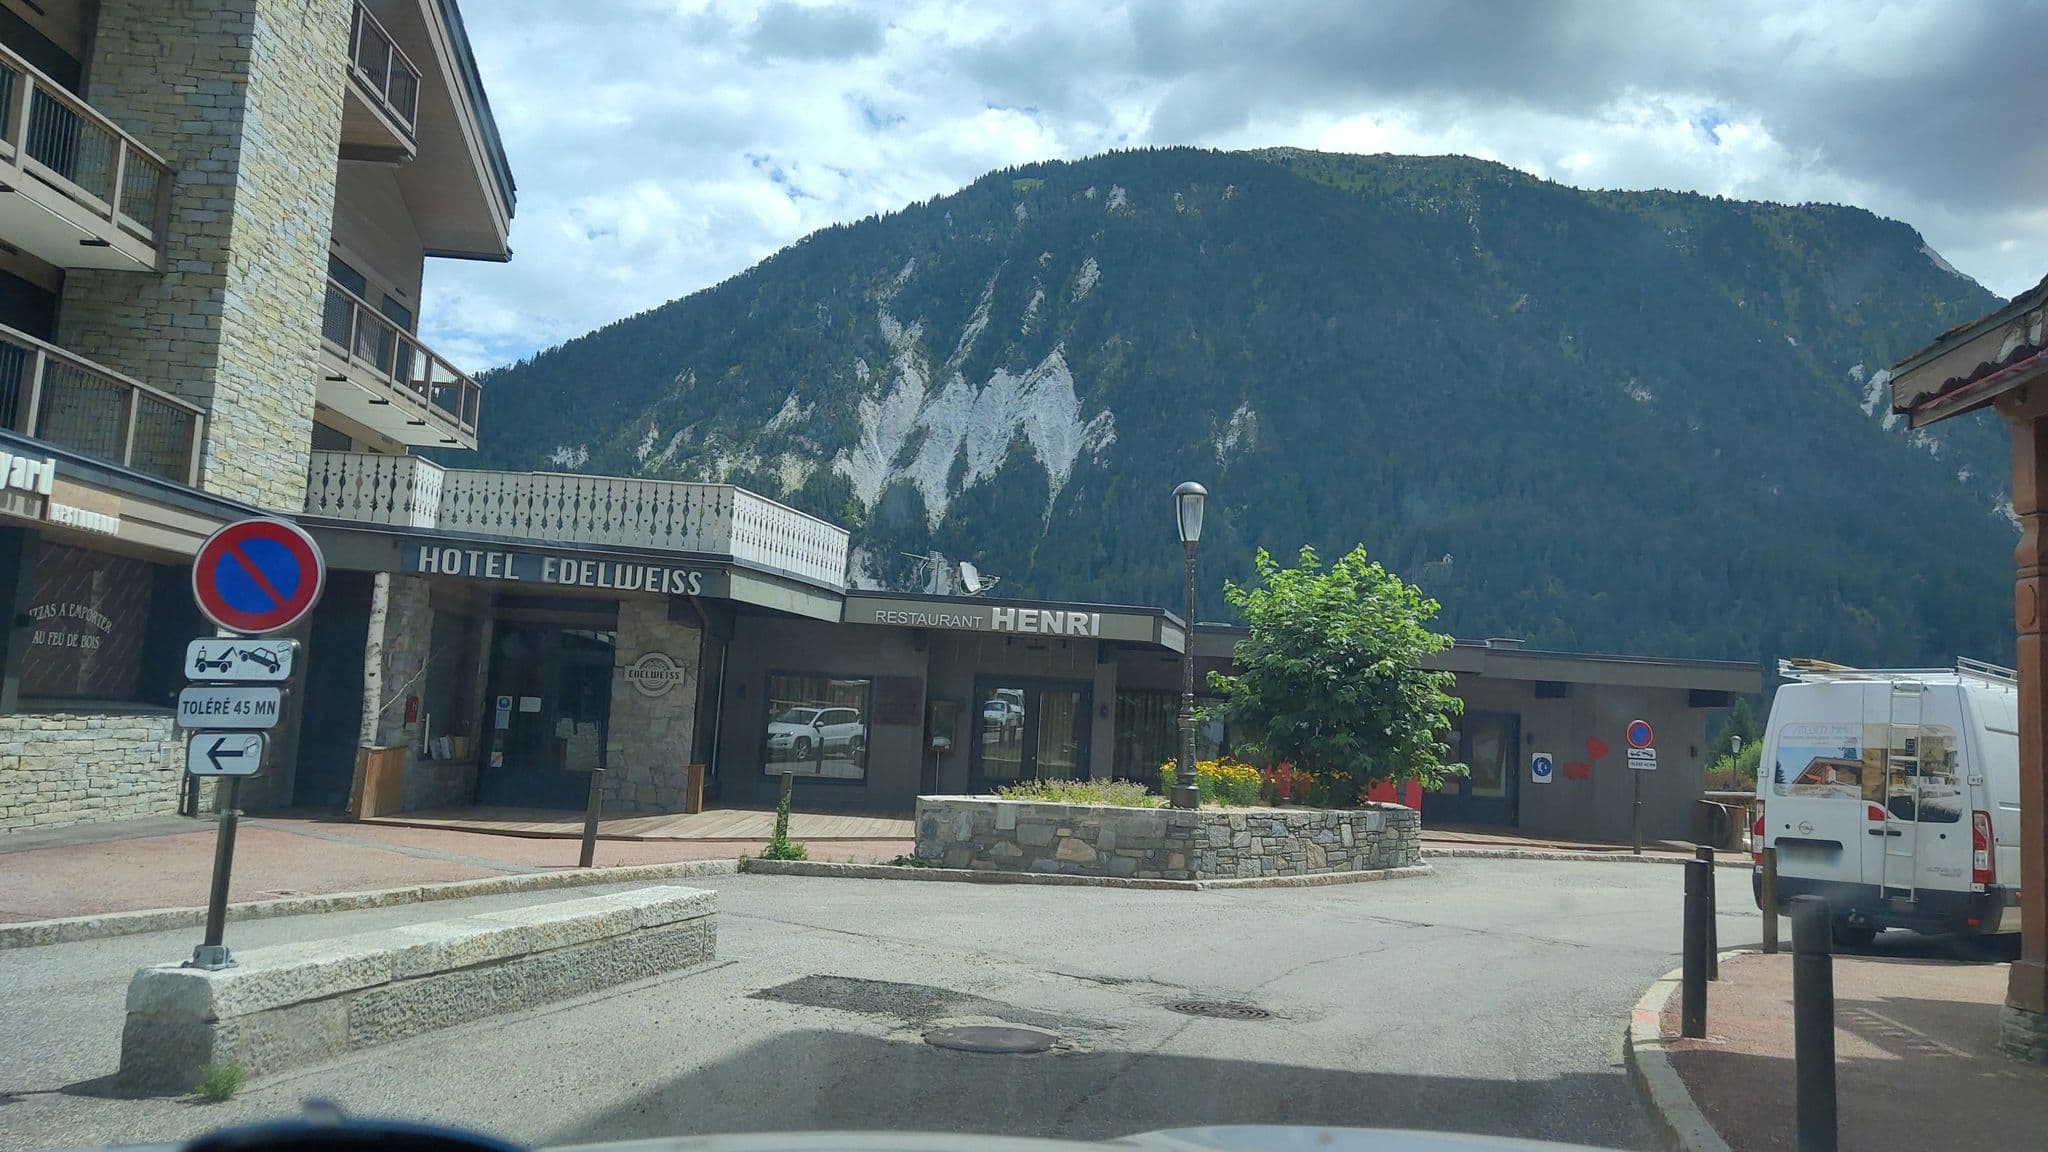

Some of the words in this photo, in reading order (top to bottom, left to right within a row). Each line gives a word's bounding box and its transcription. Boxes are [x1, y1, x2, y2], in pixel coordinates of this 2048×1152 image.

[418, 546, 520, 580] HOTEL
[541, 556, 703, 596] EDELWEISS
[59, 603, 66, 617] A
[69, 603, 112, 634] EMPORTER
[875, 610, 983, 629] RESTAURANT
[991, 607, 1101, 636] HENRI
[32, 631, 46, 644] AU
[48, 632, 65, 645] FEU
[67, 634, 78, 647] DE
[80, 635, 100, 649] BOIS
[628, 669, 681, 680] EDELWEISS
[183, 697, 231, 715] TOLÉRÉ
[233, 701, 251, 715] 45
[254, 701, 276, 715] MN
